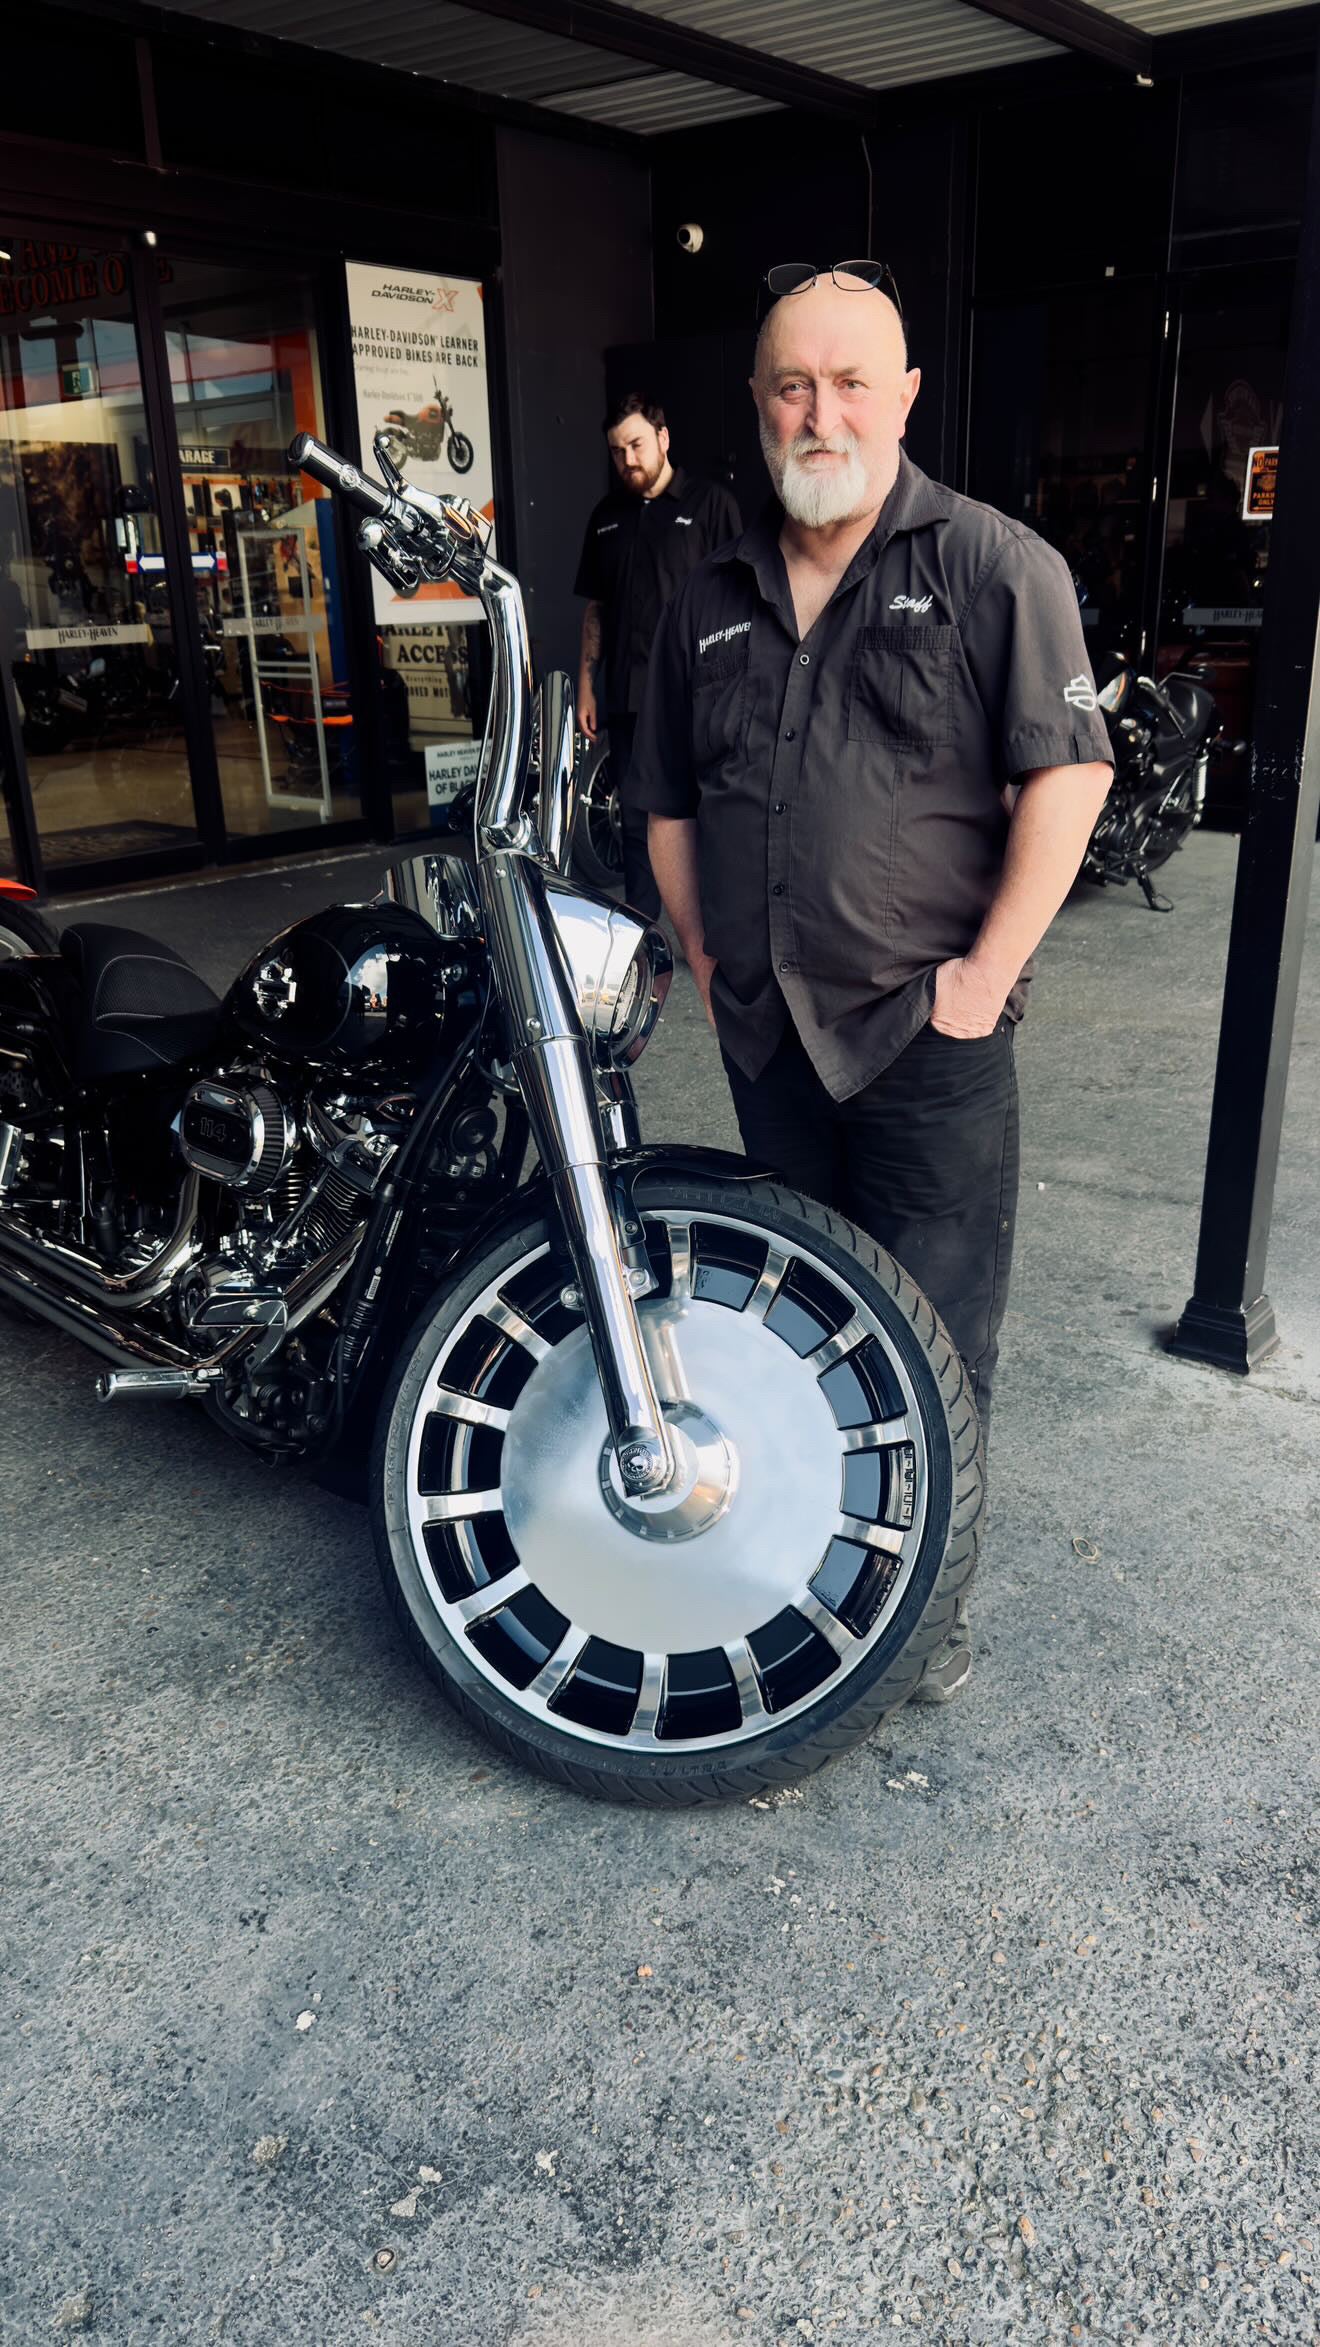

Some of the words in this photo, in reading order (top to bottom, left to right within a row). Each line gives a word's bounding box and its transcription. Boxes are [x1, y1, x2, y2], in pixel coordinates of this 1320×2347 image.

[371, 290, 434, 304] DAVIDSON
[382, 284, 436, 296] HARLEY-
[440, 336, 479, 351] LEARNER
[353, 344, 402, 360] APPROVED
[405, 349, 433, 363] BIKES
[435, 353, 452, 365] ARE
[455, 354, 479, 368] BACK
[889, 595, 934, 613] Staff
[58, 627, 118, 644] HARLEY-HEAVEN
[429, 767, 461, 781] HARLEY
[435, 782, 447, 795] OF
